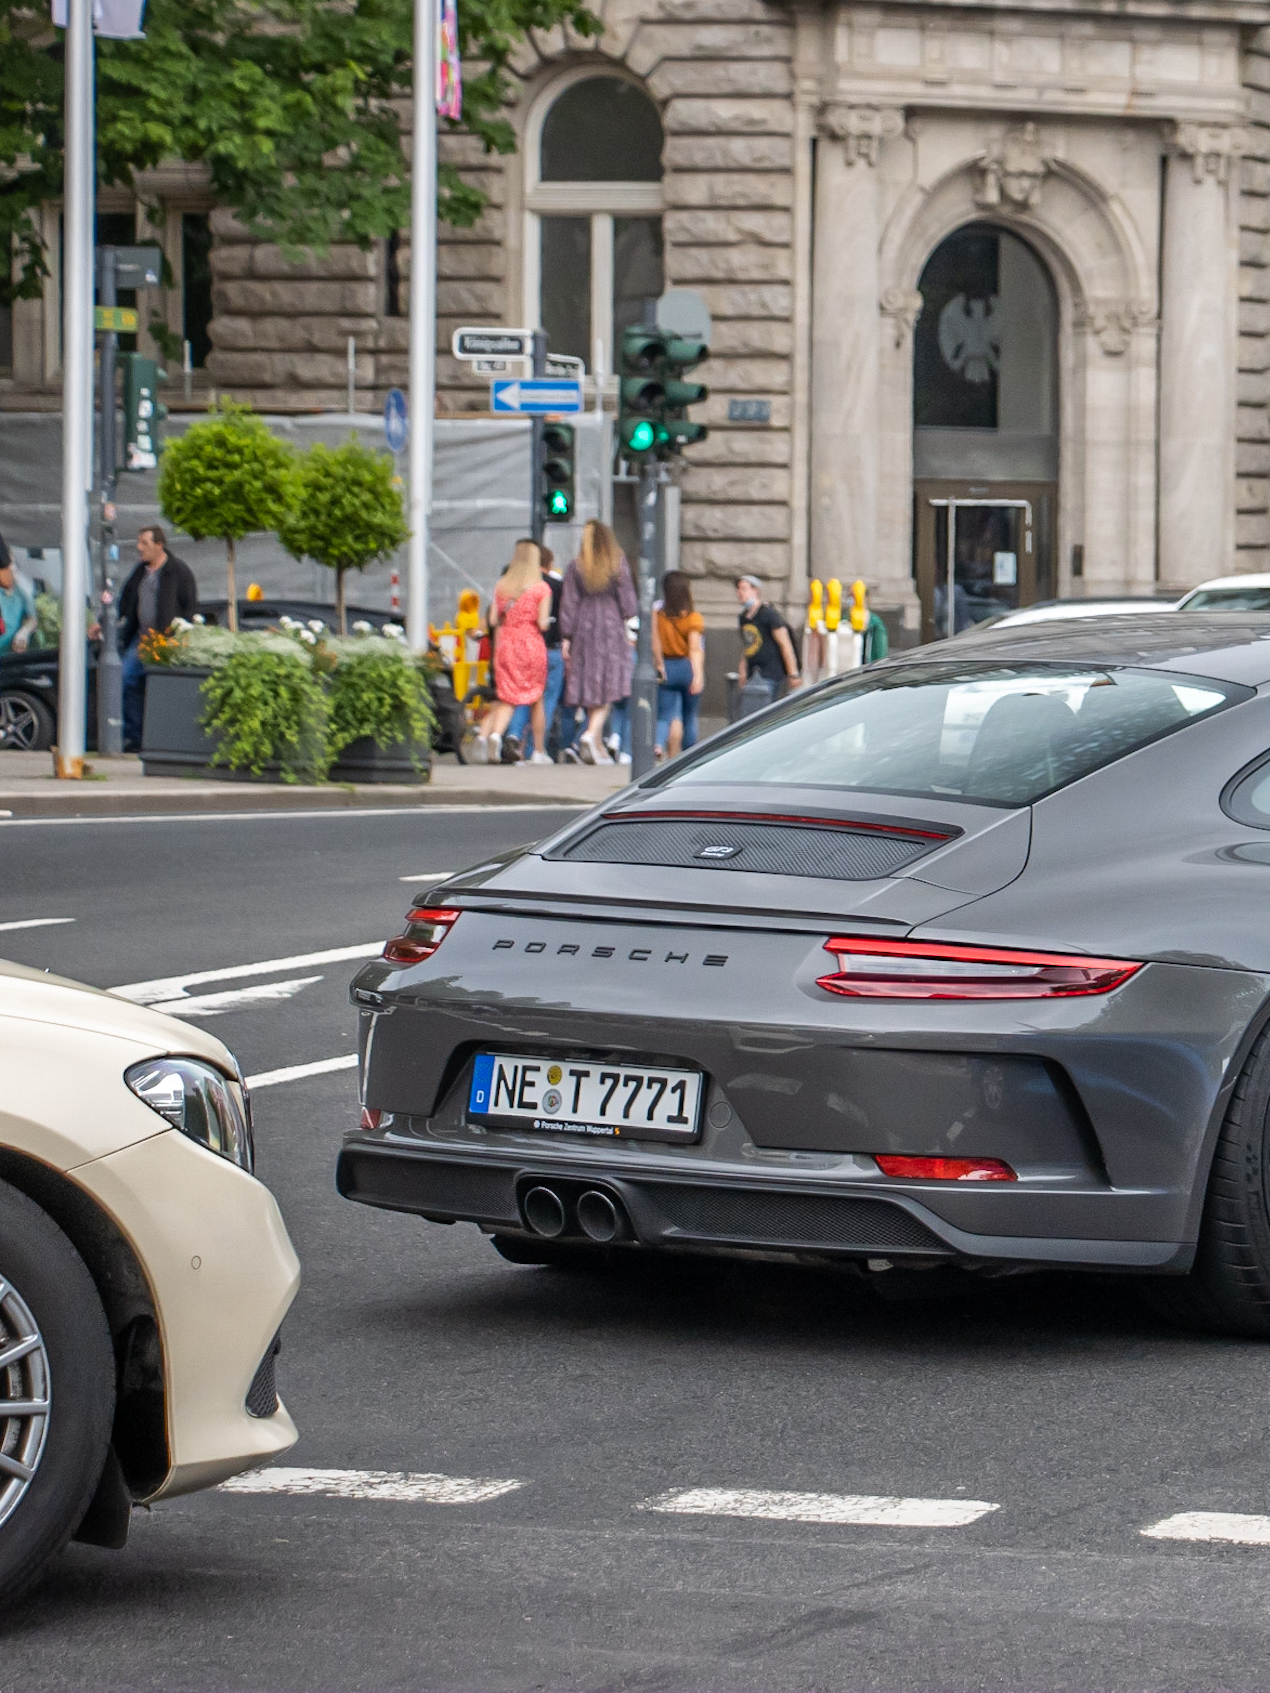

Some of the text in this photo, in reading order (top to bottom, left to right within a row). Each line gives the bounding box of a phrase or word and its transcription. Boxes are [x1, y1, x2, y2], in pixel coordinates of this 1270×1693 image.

[492, 940, 728, 967] PORSCHE
[476, 1090, 485, 1103] D
[493, 1063, 689, 1125] NE T 7771
[541, 1120, 614, 1135] Porsche Zentrum Wuppertal
